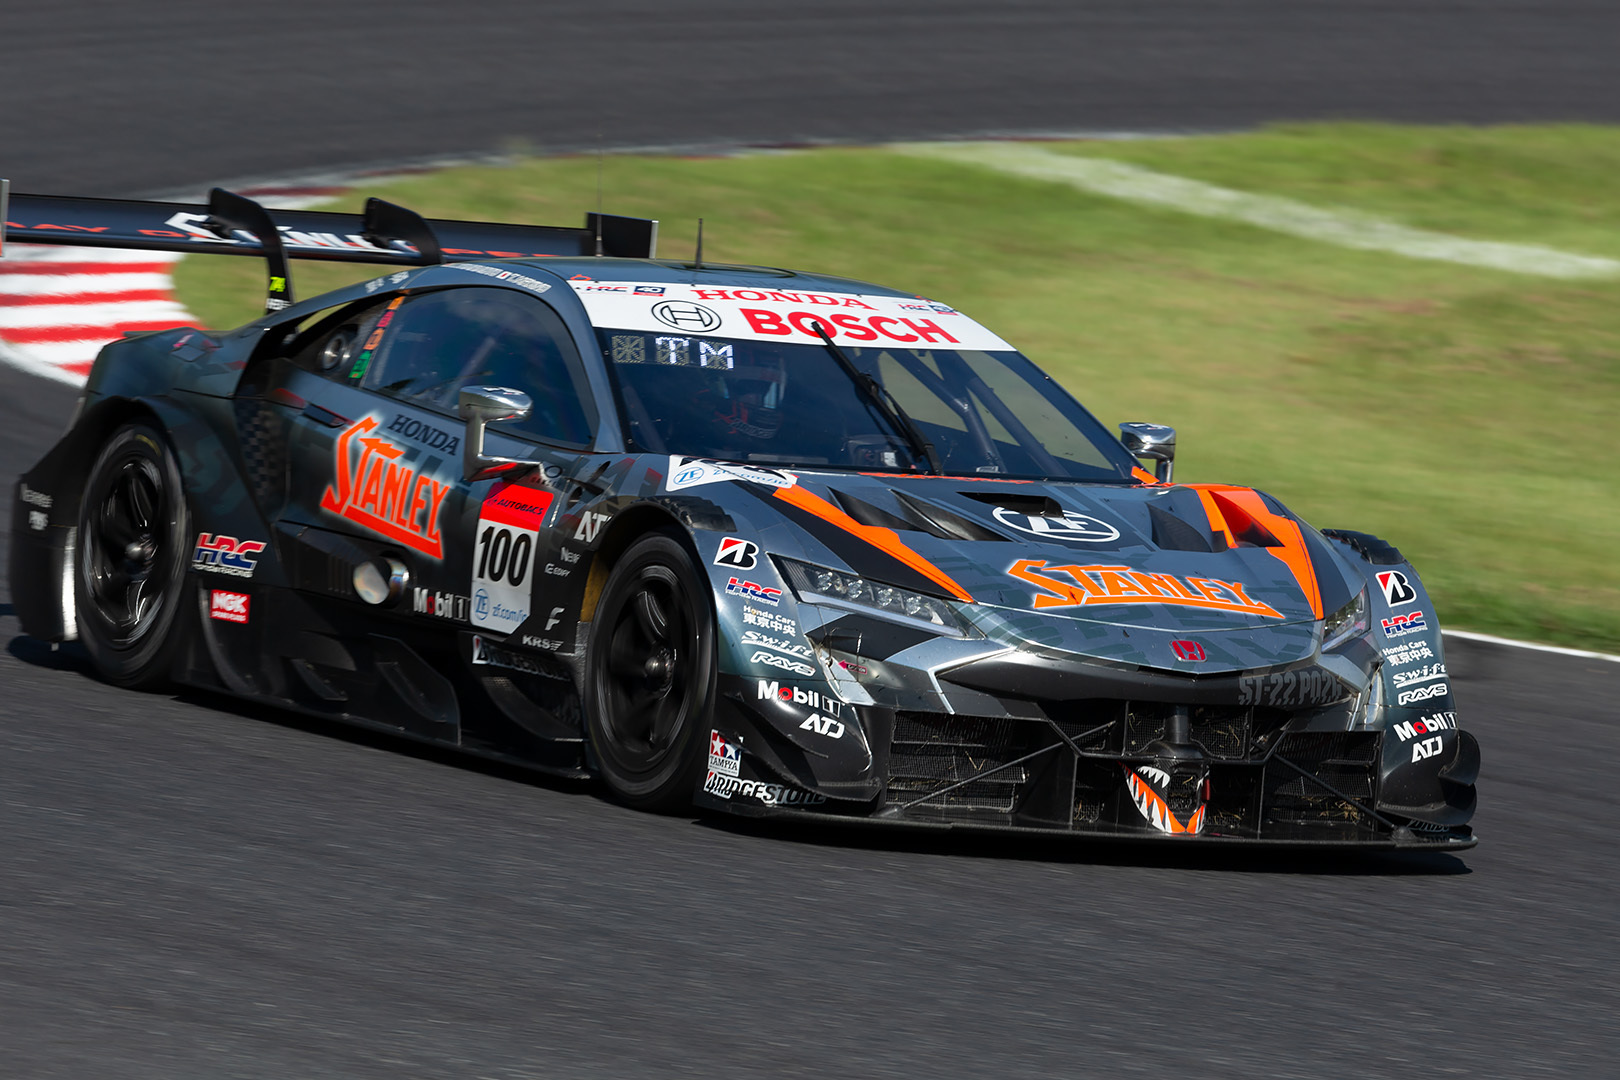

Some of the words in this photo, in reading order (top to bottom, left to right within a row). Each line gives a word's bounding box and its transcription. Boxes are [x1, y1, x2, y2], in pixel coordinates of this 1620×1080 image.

[690, 289, 879, 311] HONDA
[739, 307, 961, 344] BOSCH
[387, 414, 461, 456] HONDA
[320, 415, 451, 560] STANLEY
[497, 499, 545, 516] AUTOBACS
[574, 511, 613, 543] AT
[192, 532, 268, 571] HRC
[477, 525, 532, 587] 100
[725, 576, 783, 605] HRC
[1007, 559, 1286, 619] STANLEY
[212, 592, 247, 614] NGK
[413, 587, 454, 619] Mobil
[743, 605, 774, 620] Honda
[775, 614, 796, 627] Cars
[742, 612, 796, 637] 東京中央
[1381, 611, 1428, 635] HRC
[522, 634, 551, 650] KRS
[1382, 644, 1409, 656] Honda
[1408, 640, 1427, 649] Cars
[750, 651, 816, 677] RAYS
[1387, 647, 1434, 667] 東京中央
[757, 680, 820, 708] Mobil
[1238, 671, 1297, 705] ST-22
[1398, 682, 1448, 706] RAYS
[1393, 713, 1449, 742] Mobil
[709, 756, 738, 771] TAMIYA
